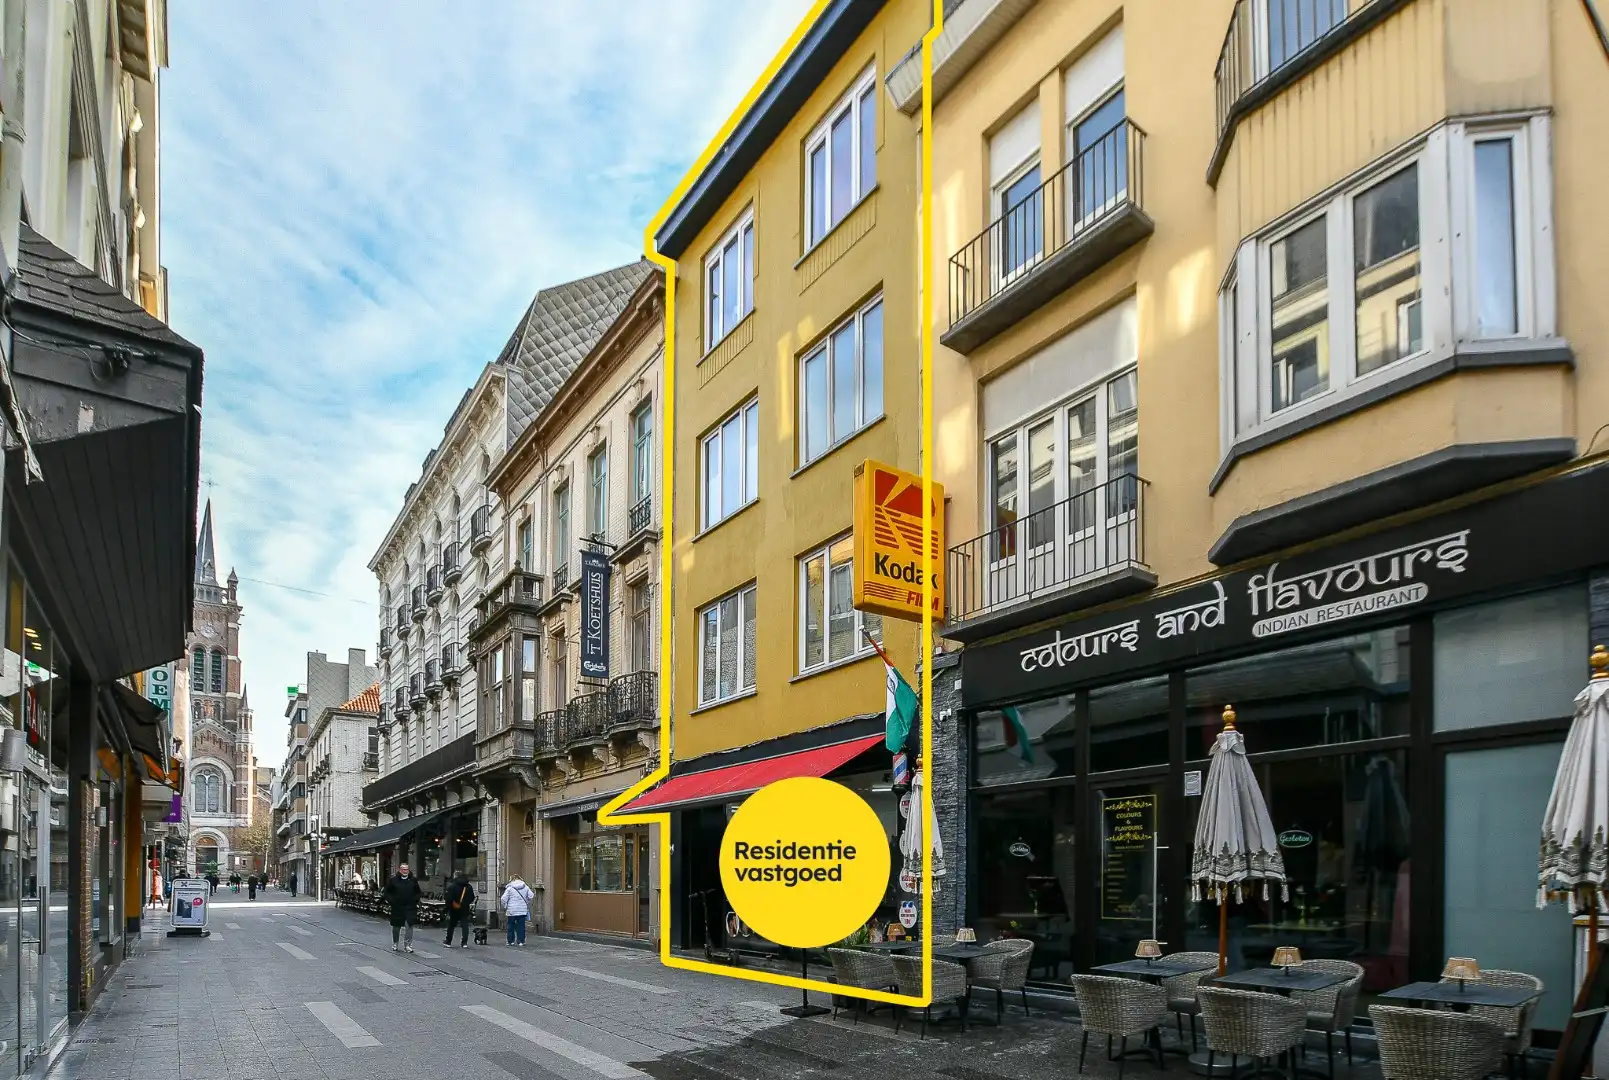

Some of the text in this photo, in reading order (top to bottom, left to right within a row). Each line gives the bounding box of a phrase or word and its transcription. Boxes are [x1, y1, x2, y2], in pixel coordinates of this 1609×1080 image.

[588, 572, 601, 640] KOETSHUIS
[1020, 528, 1471, 672] colours and flavours
[1257, 585, 1424, 636] INDIAN RESTAURANT
[1116, 811, 1142, 819] COLOURS
